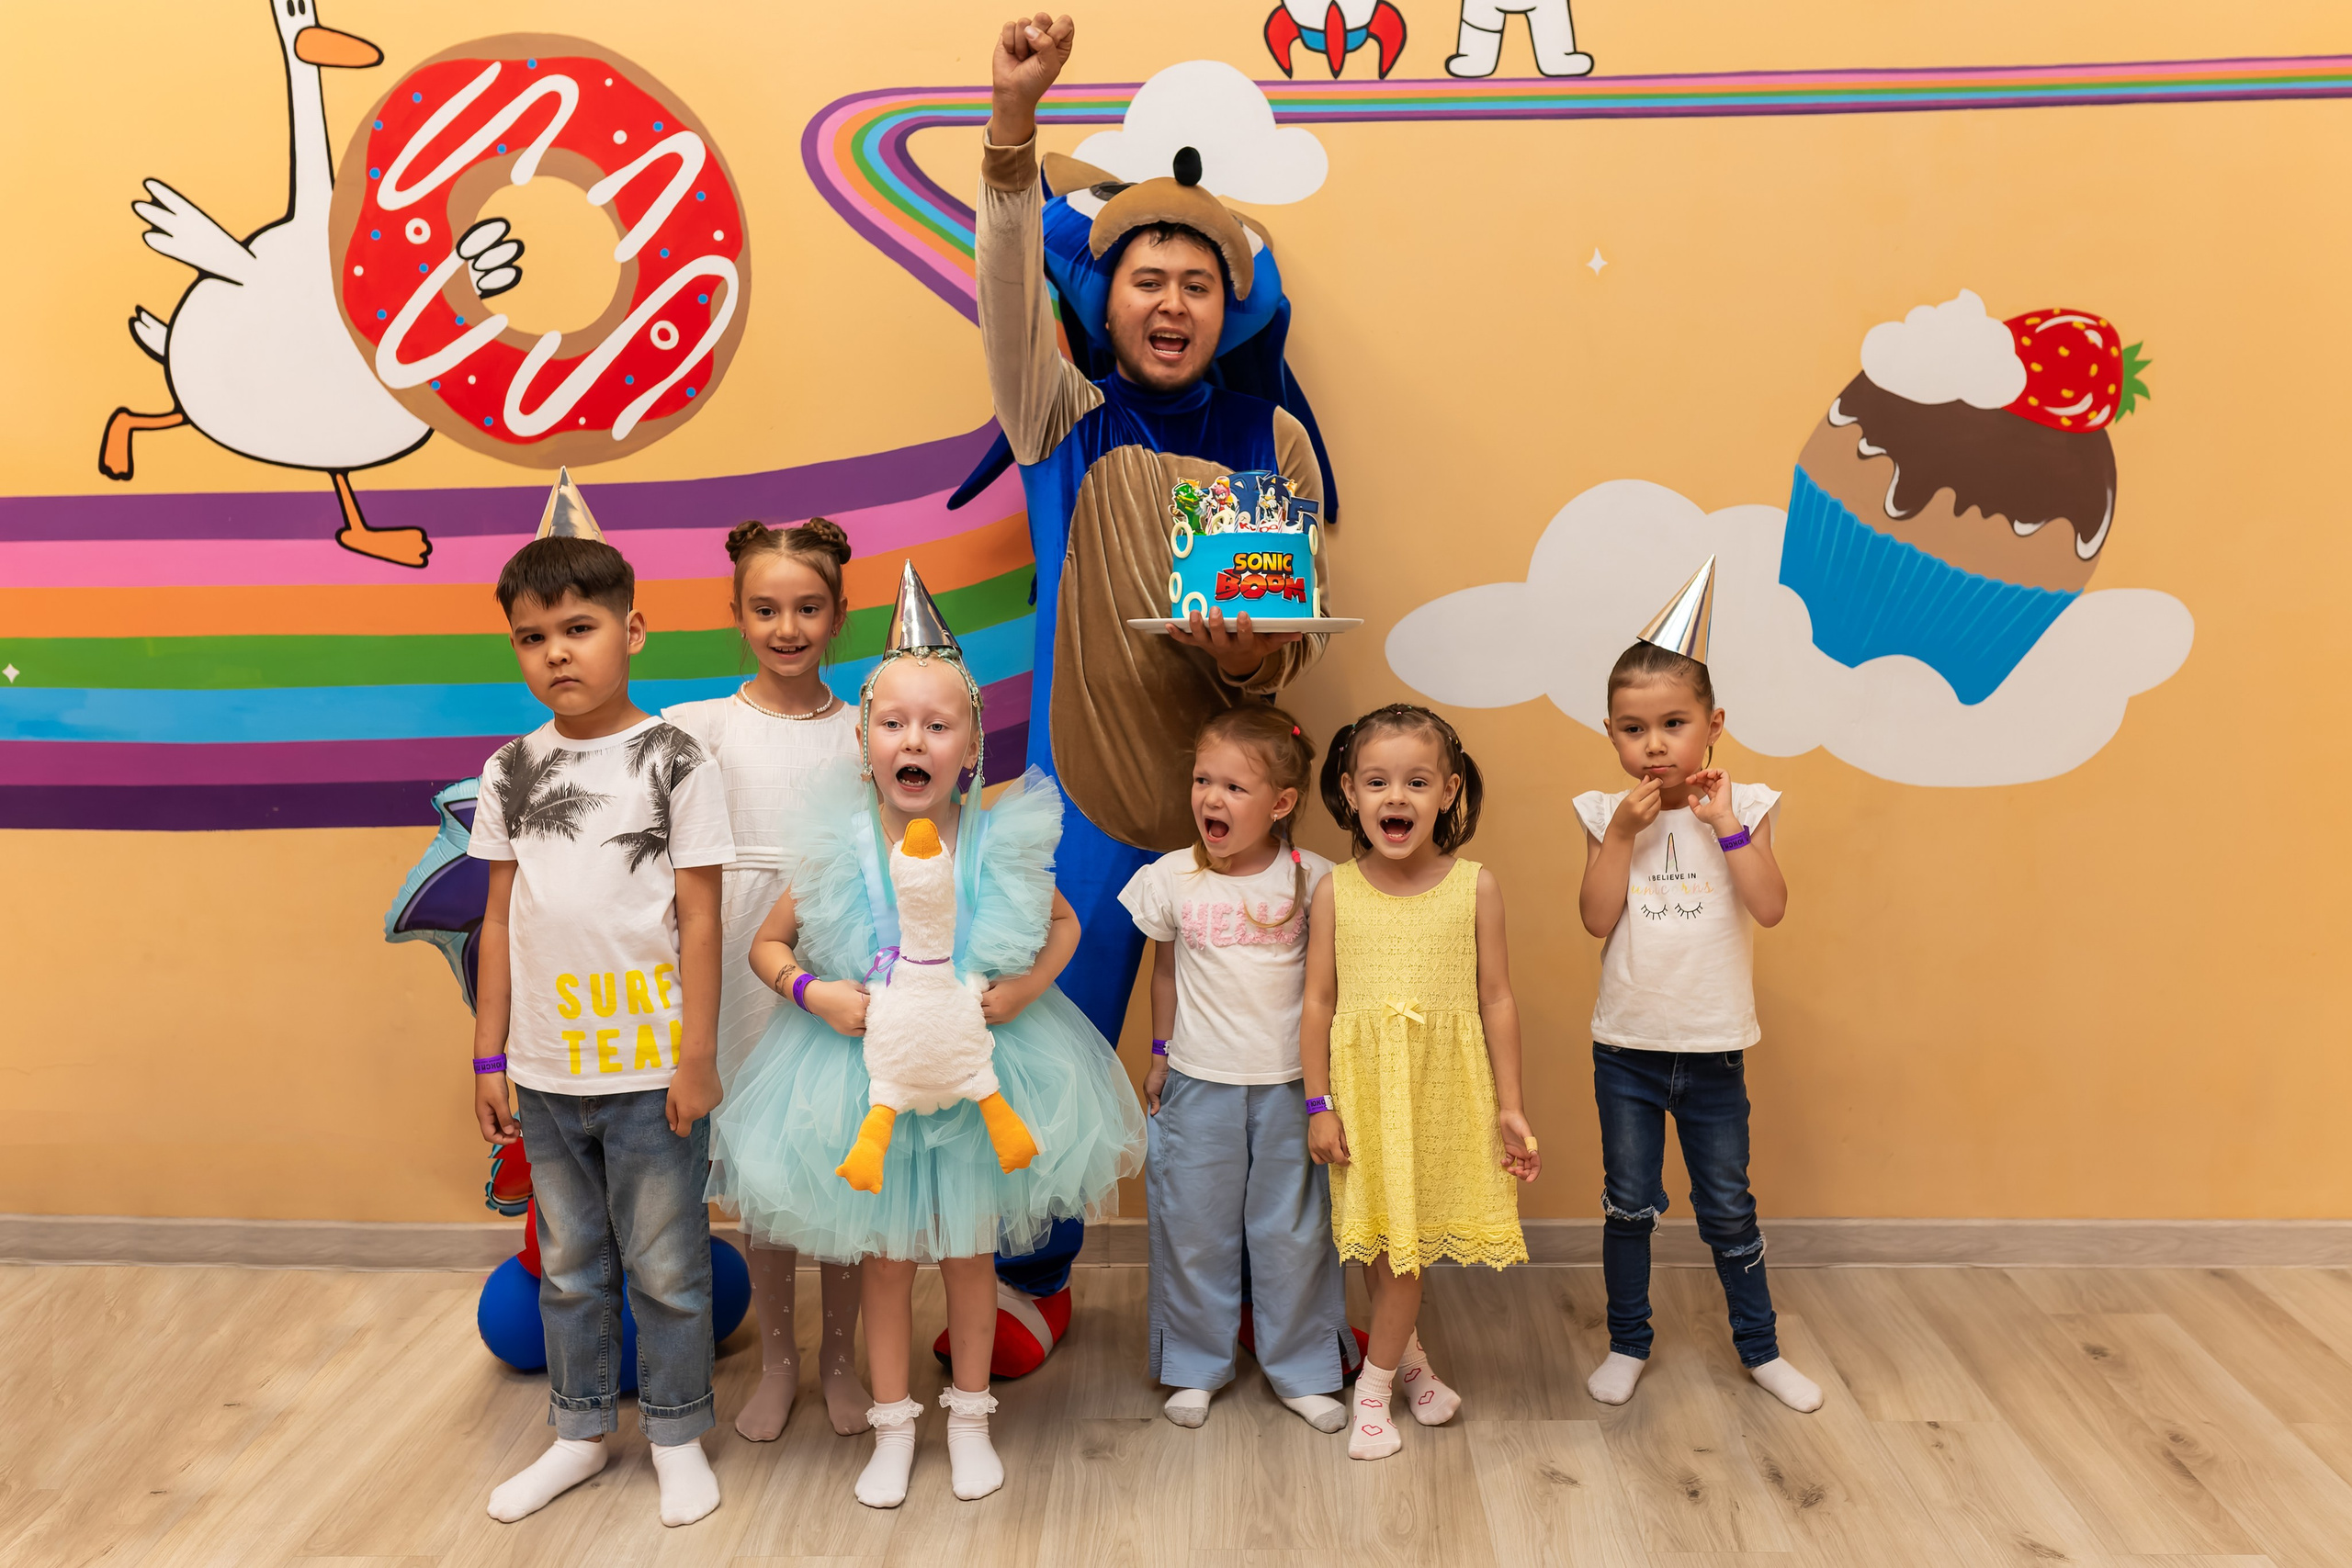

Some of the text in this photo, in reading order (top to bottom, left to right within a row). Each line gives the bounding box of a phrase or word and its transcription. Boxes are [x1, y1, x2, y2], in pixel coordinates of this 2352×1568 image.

[1234, 552, 1294, 573] SONIC
[1215, 569, 1306, 604] BOOM
[1652, 873, 1685, 882] BELIEVE
[1181, 899, 1305, 950] HELLO
[555, 963, 674, 1020] SURF
